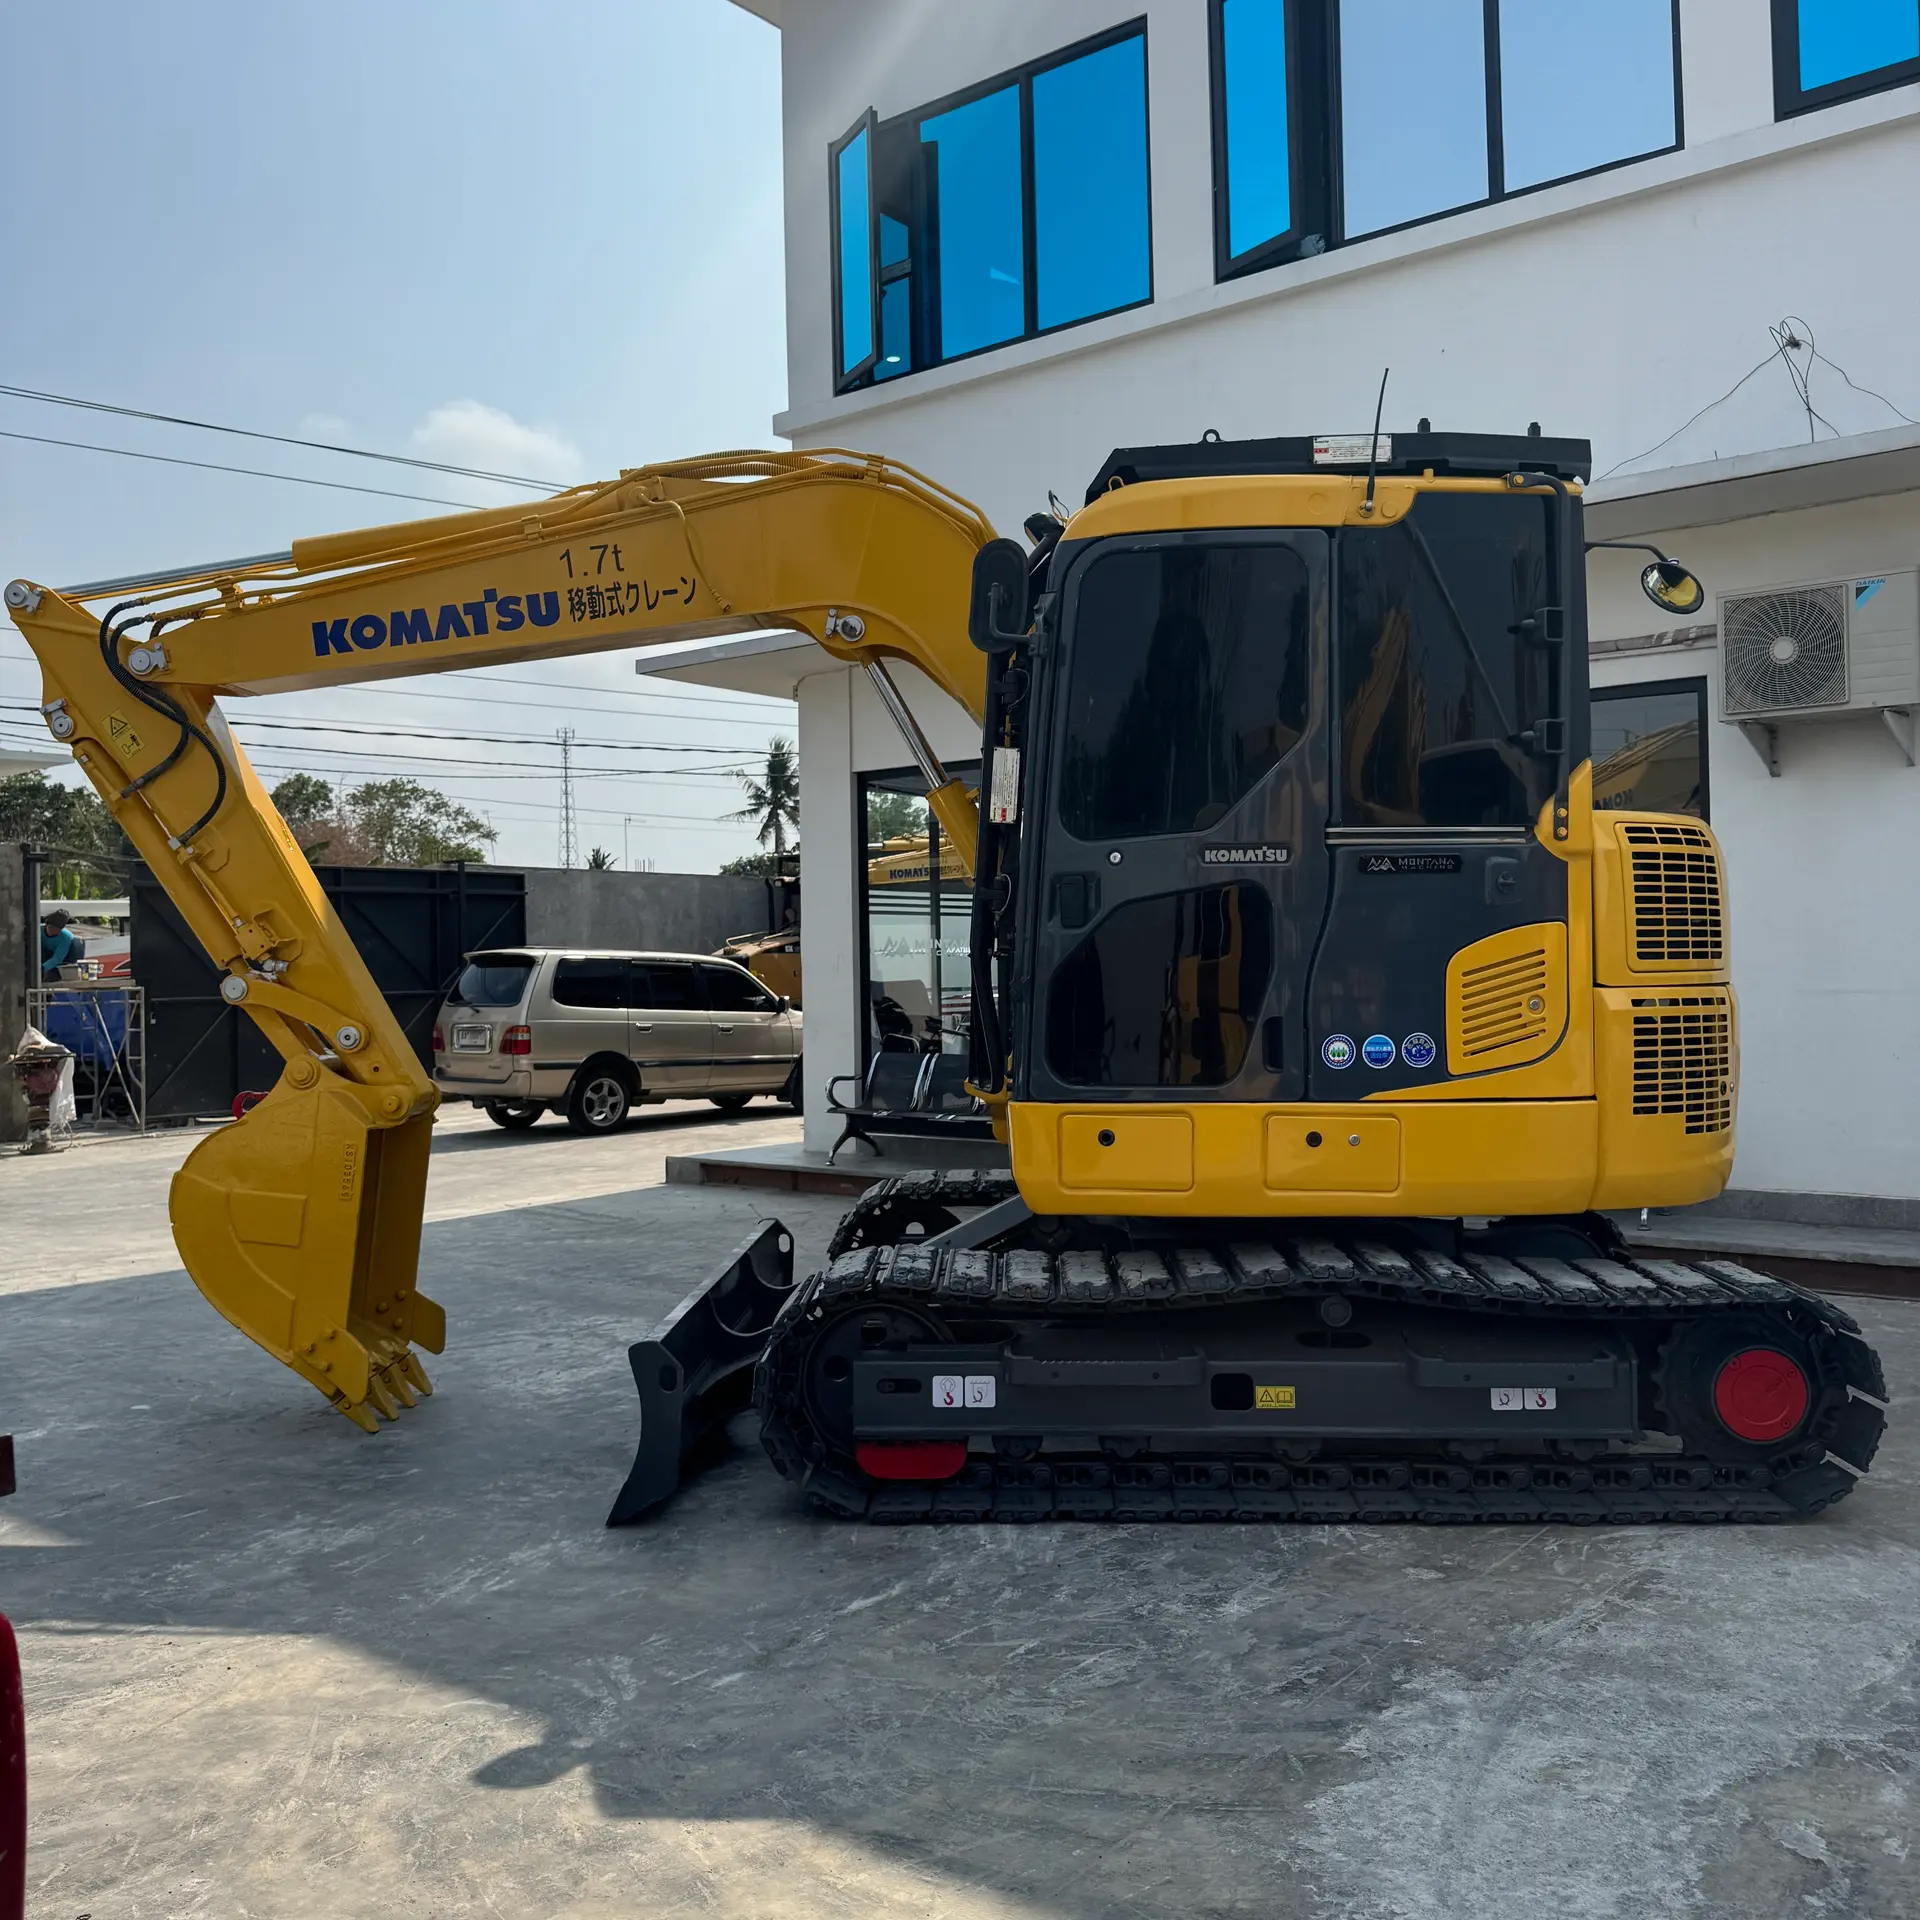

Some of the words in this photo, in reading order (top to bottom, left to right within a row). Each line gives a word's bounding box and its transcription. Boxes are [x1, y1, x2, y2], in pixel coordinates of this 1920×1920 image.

[560, 543, 625, 578] 1.7t
[1856, 578, 1887, 586] DAIKIN
[567, 577, 696, 622] 移動式クレーン
[311, 587, 561, 657] KOMATSU
[1204, 846, 1287, 862] KOMATSU
[1398, 857, 1455, 866] MONTANA
[889, 864, 930, 879] KOMATS
